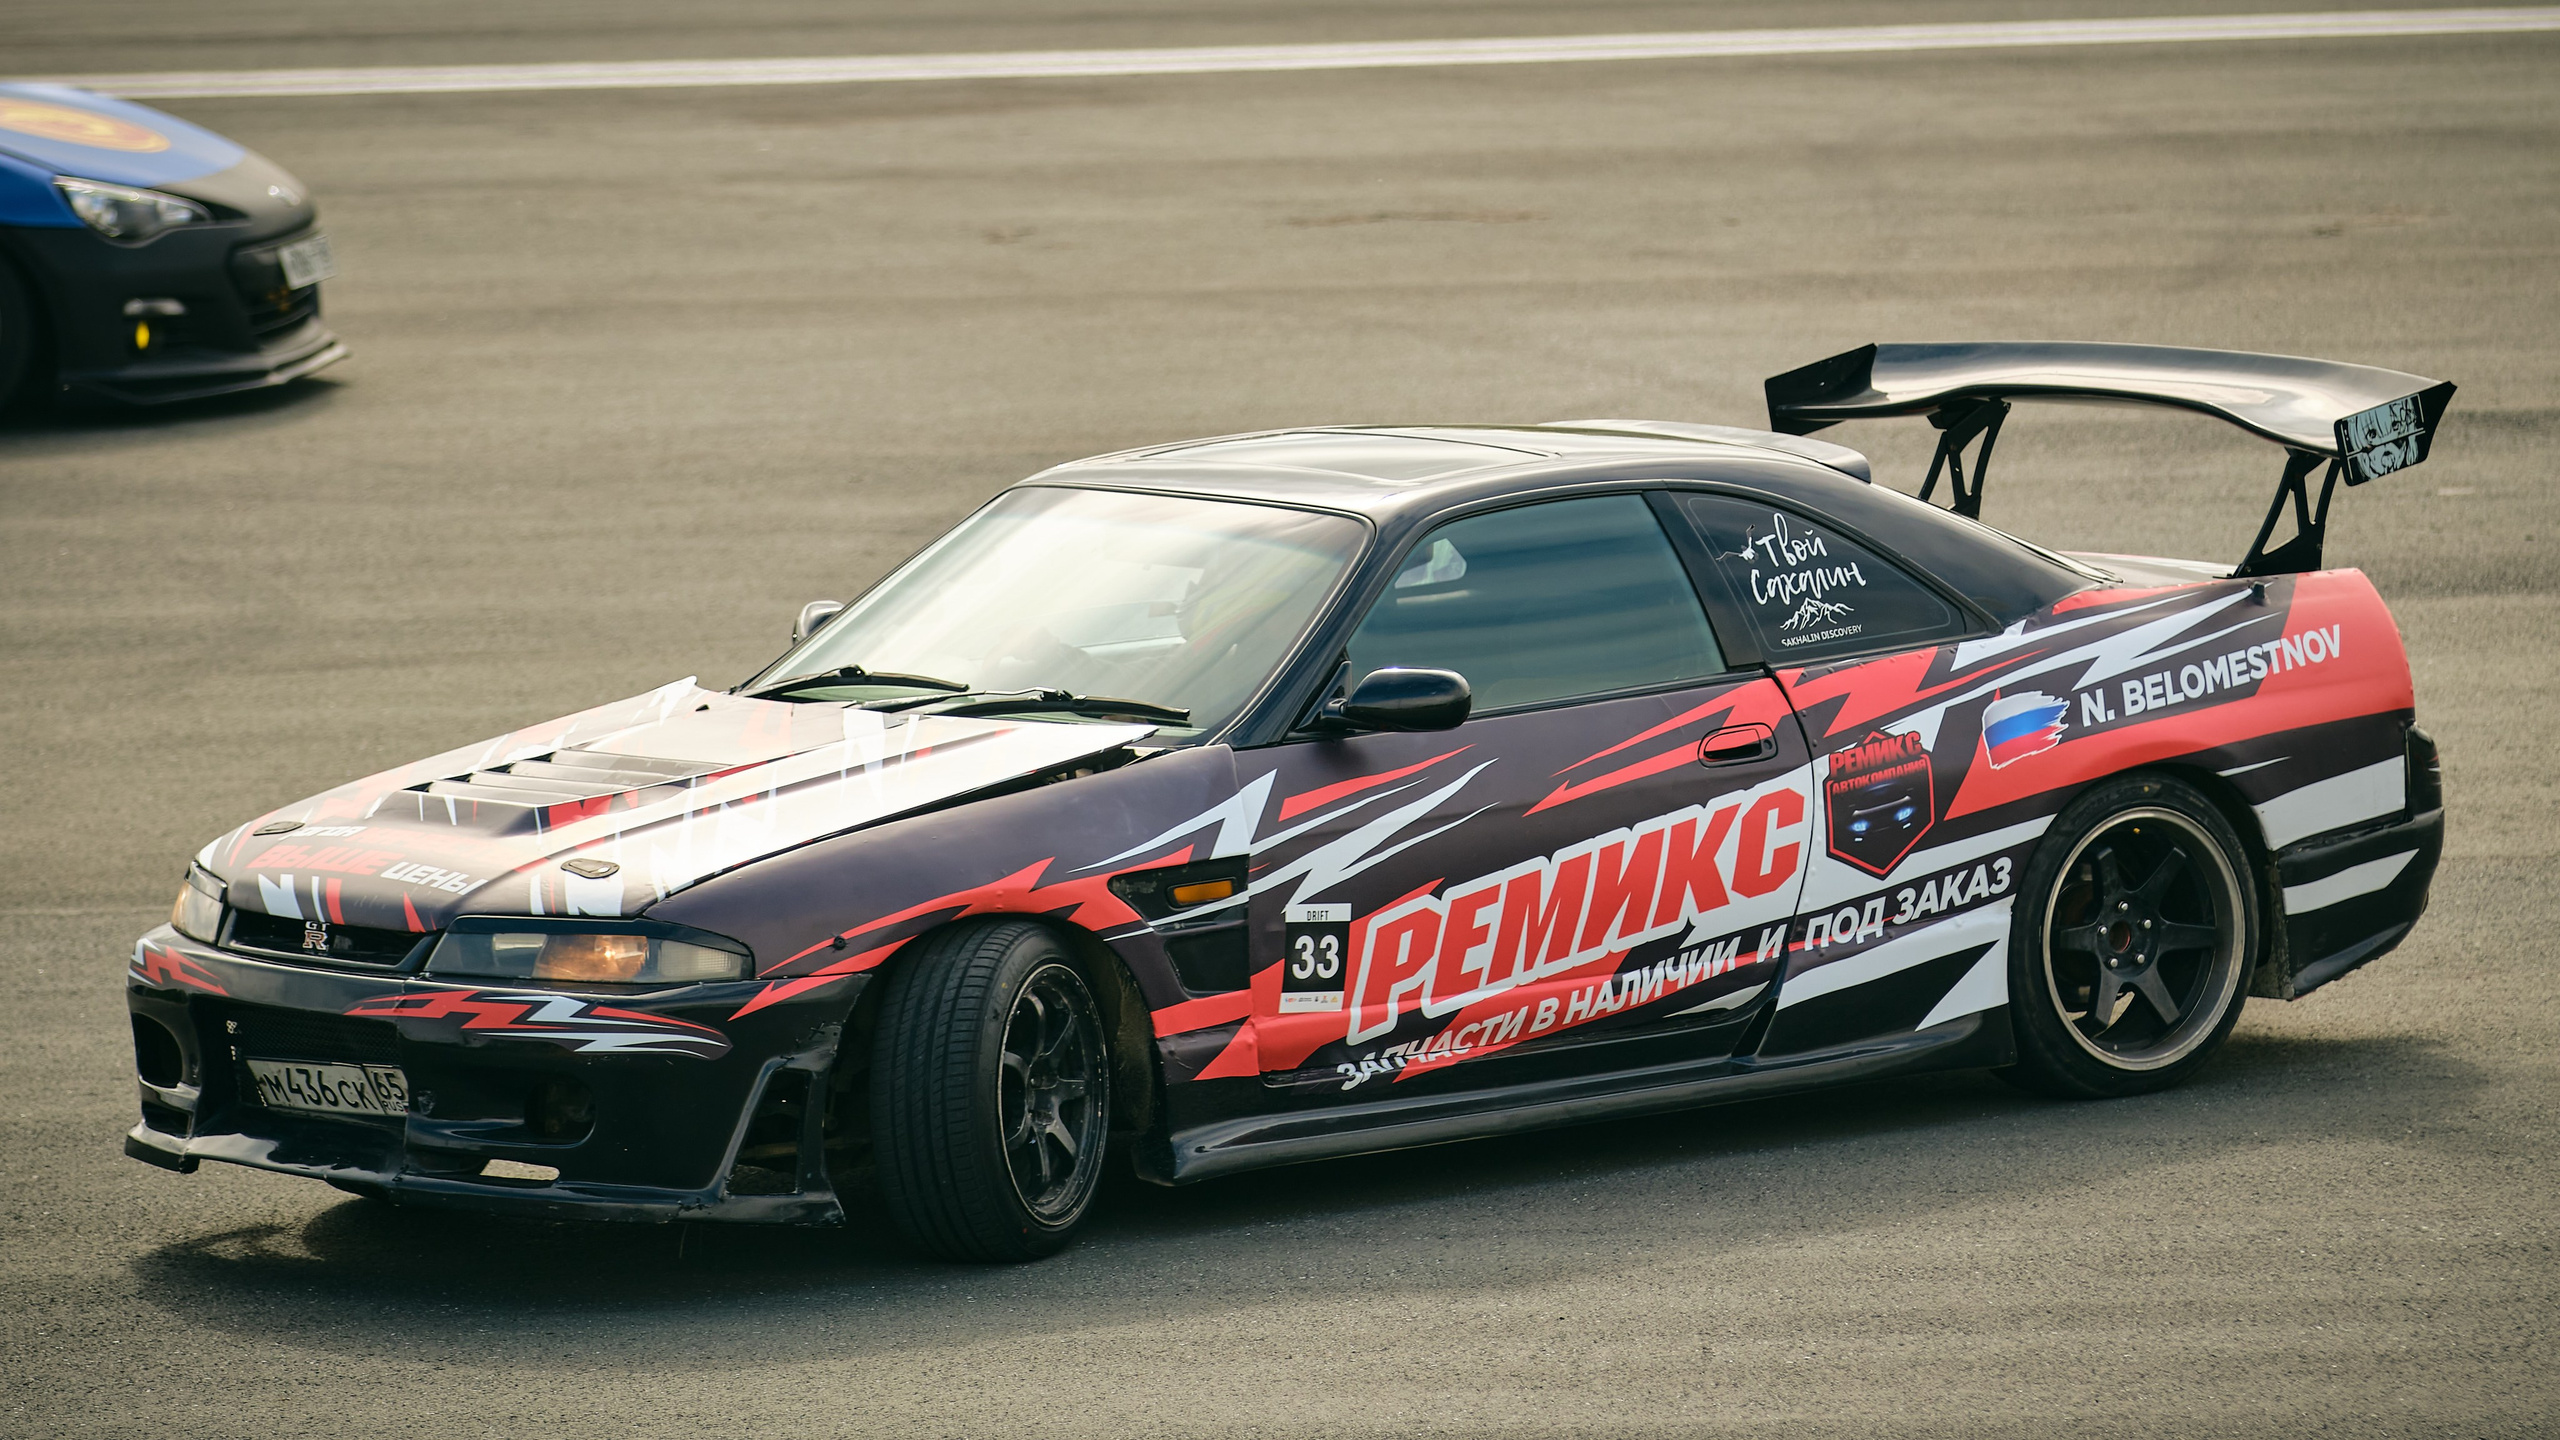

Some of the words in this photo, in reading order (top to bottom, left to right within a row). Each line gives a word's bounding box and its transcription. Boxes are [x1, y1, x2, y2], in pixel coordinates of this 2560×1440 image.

[1755, 512, 1828, 567] Твой
[1751, 562, 1867, 605] Сахалин
[1781, 631, 1821, 647] SAKHALIN
[1821, 624, 1863, 641] DISCOVERY
[2079, 688, 2116, 728] N.
[2121, 623, 2341, 717] BELOMESTNOV
[1829, 730, 1923, 778] РЕМИКС
[1832, 758, 1927, 796] АВТОКОМПАНИЯ
[246, 844, 406, 876] ВЫШЕ
[380, 861, 489, 896] ЦЕНЫ
[1306, 910, 1330, 922] DRIFT
[1354, 786, 1806, 1036] РЕМИКС
[302, 929, 328, 951] R
[1292, 934, 1341, 980] 33
[1336, 1009, 1527, 1091] ЗАПЧАСТИ
[1528, 997, 1560, 1034] В
[1562, 936, 1740, 1025] НАЛИЧИИ
[1755, 923, 1788, 964] И
[1803, 896, 1887, 952] ПОД
[1892, 856, 2014, 926] ЗАКАЗ
[373, 1071, 407, 1100] 65
[381, 1100, 405, 1113] RUS
